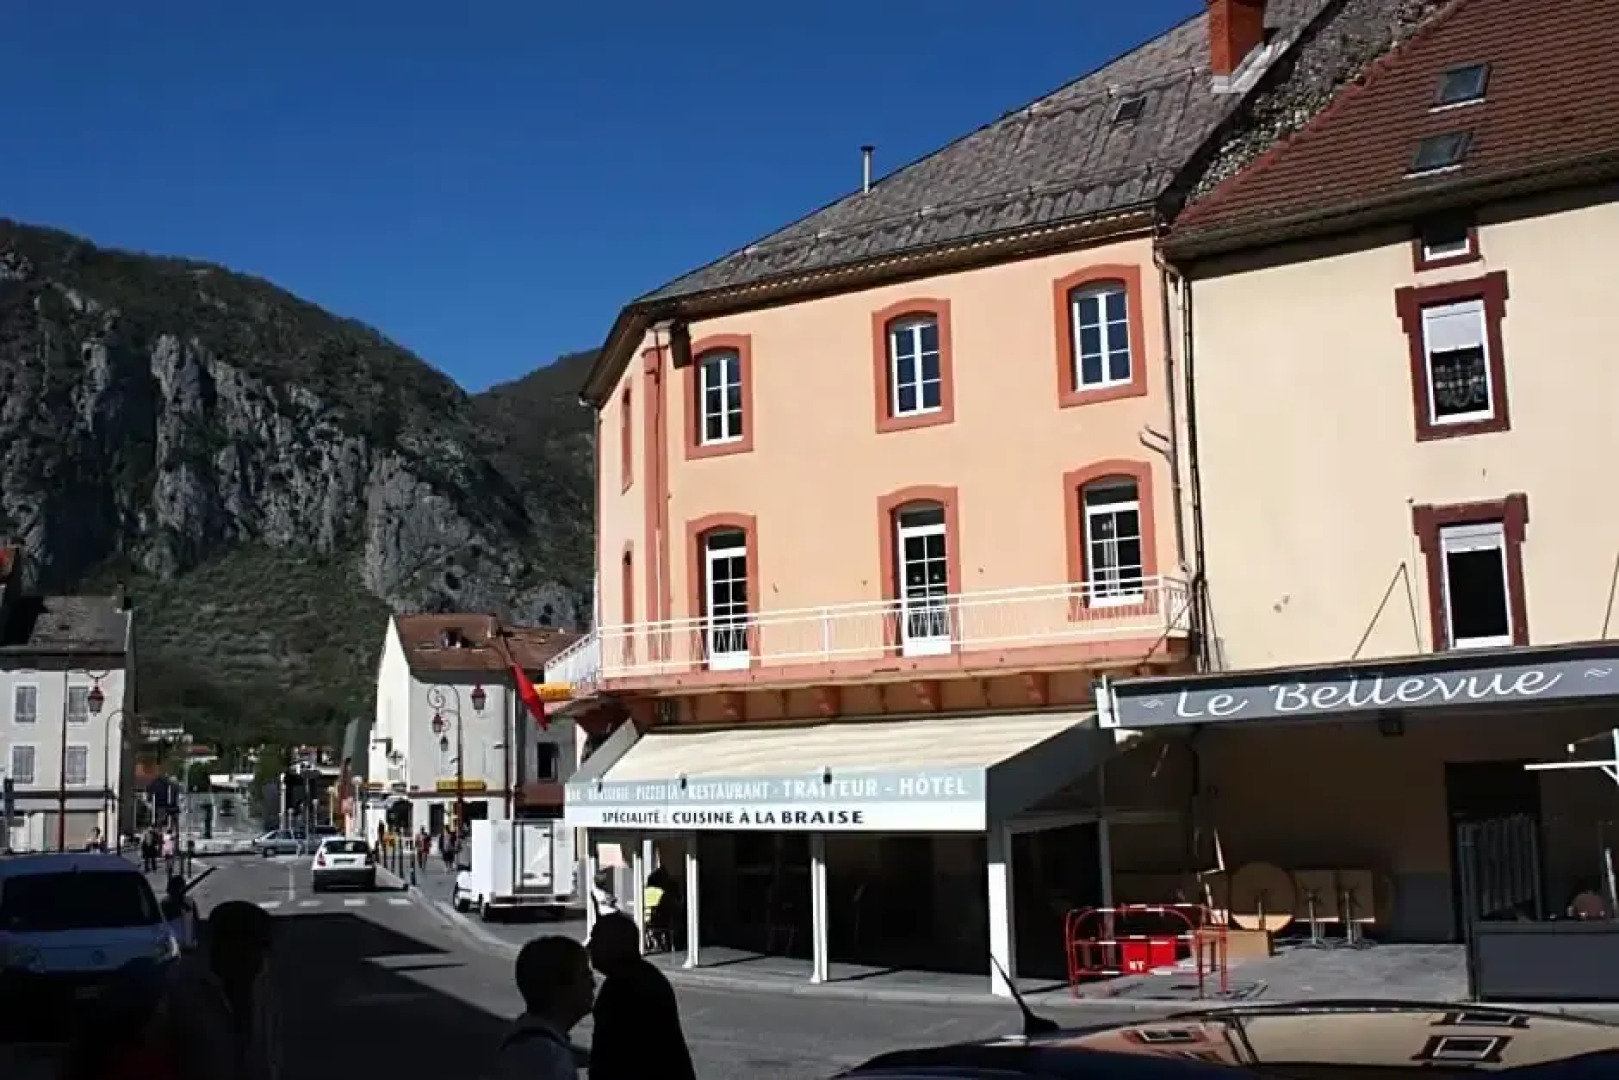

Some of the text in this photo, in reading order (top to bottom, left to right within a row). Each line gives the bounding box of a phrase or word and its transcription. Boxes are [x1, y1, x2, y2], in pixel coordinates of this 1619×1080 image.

[1175, 668, 1562, 718] Le Bellevue
[688, 781, 770, 800] RESTAURANT
[782, 778, 878, 798] TRAITEUR
[900, 772, 967, 796] HÔTEL
[672, 811, 735, 824] CUISINE
[739, 808, 751, 824] À
[755, 812, 776, 824] LA
[782, 811, 864, 824] BRAISE
